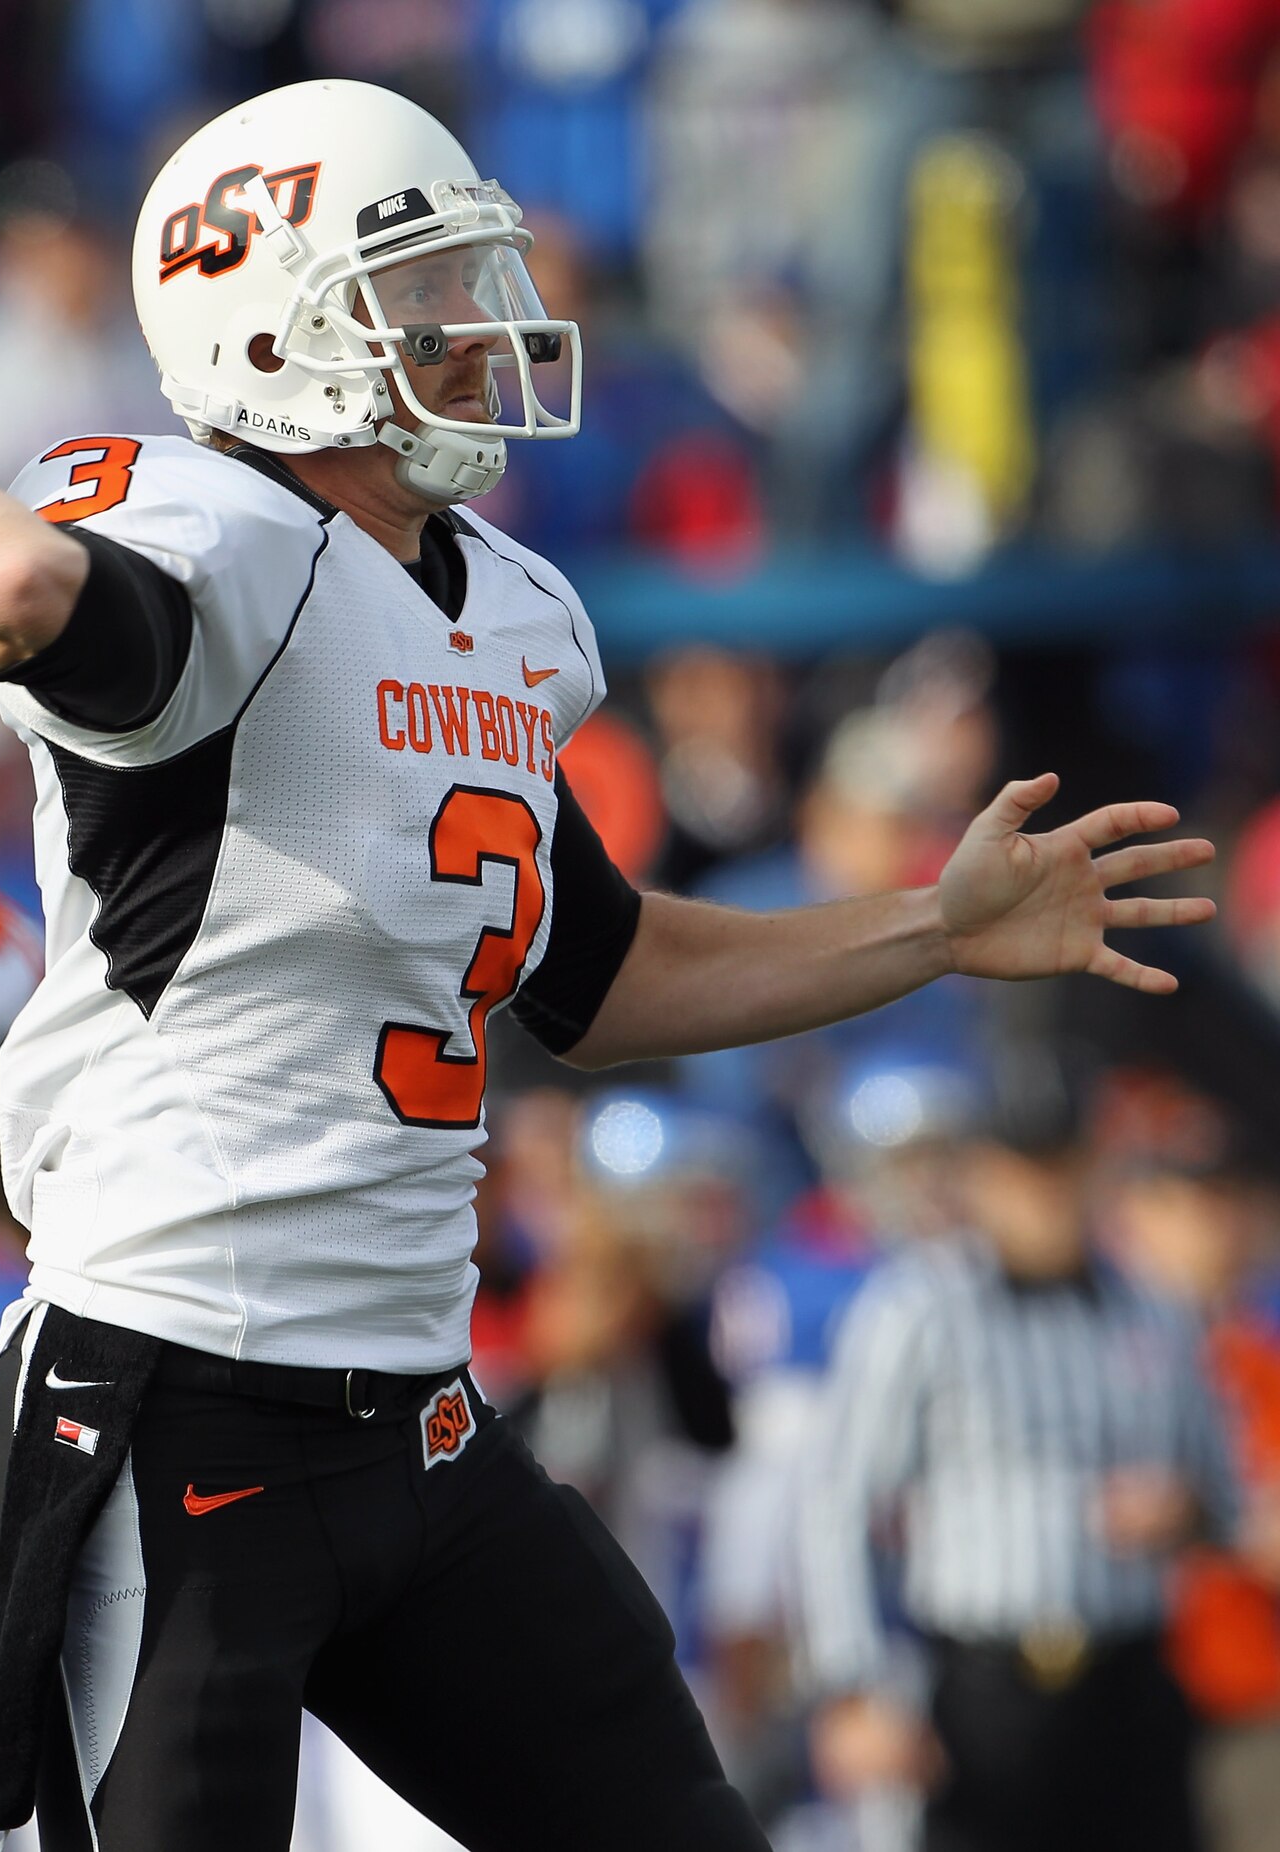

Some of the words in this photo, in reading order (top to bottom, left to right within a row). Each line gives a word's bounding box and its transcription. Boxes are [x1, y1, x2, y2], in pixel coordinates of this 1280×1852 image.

[159, 161, 322, 286] OSU
[377, 193, 408, 220] NIKE
[237, 408, 311, 441] ADAMS
[33, 436, 143, 524] 3
[450, 631, 474, 653] OSU
[376, 679, 554, 782] COWBOYS
[372, 783, 545, 1129] 3
[427, 1388, 471, 1456] OSU
